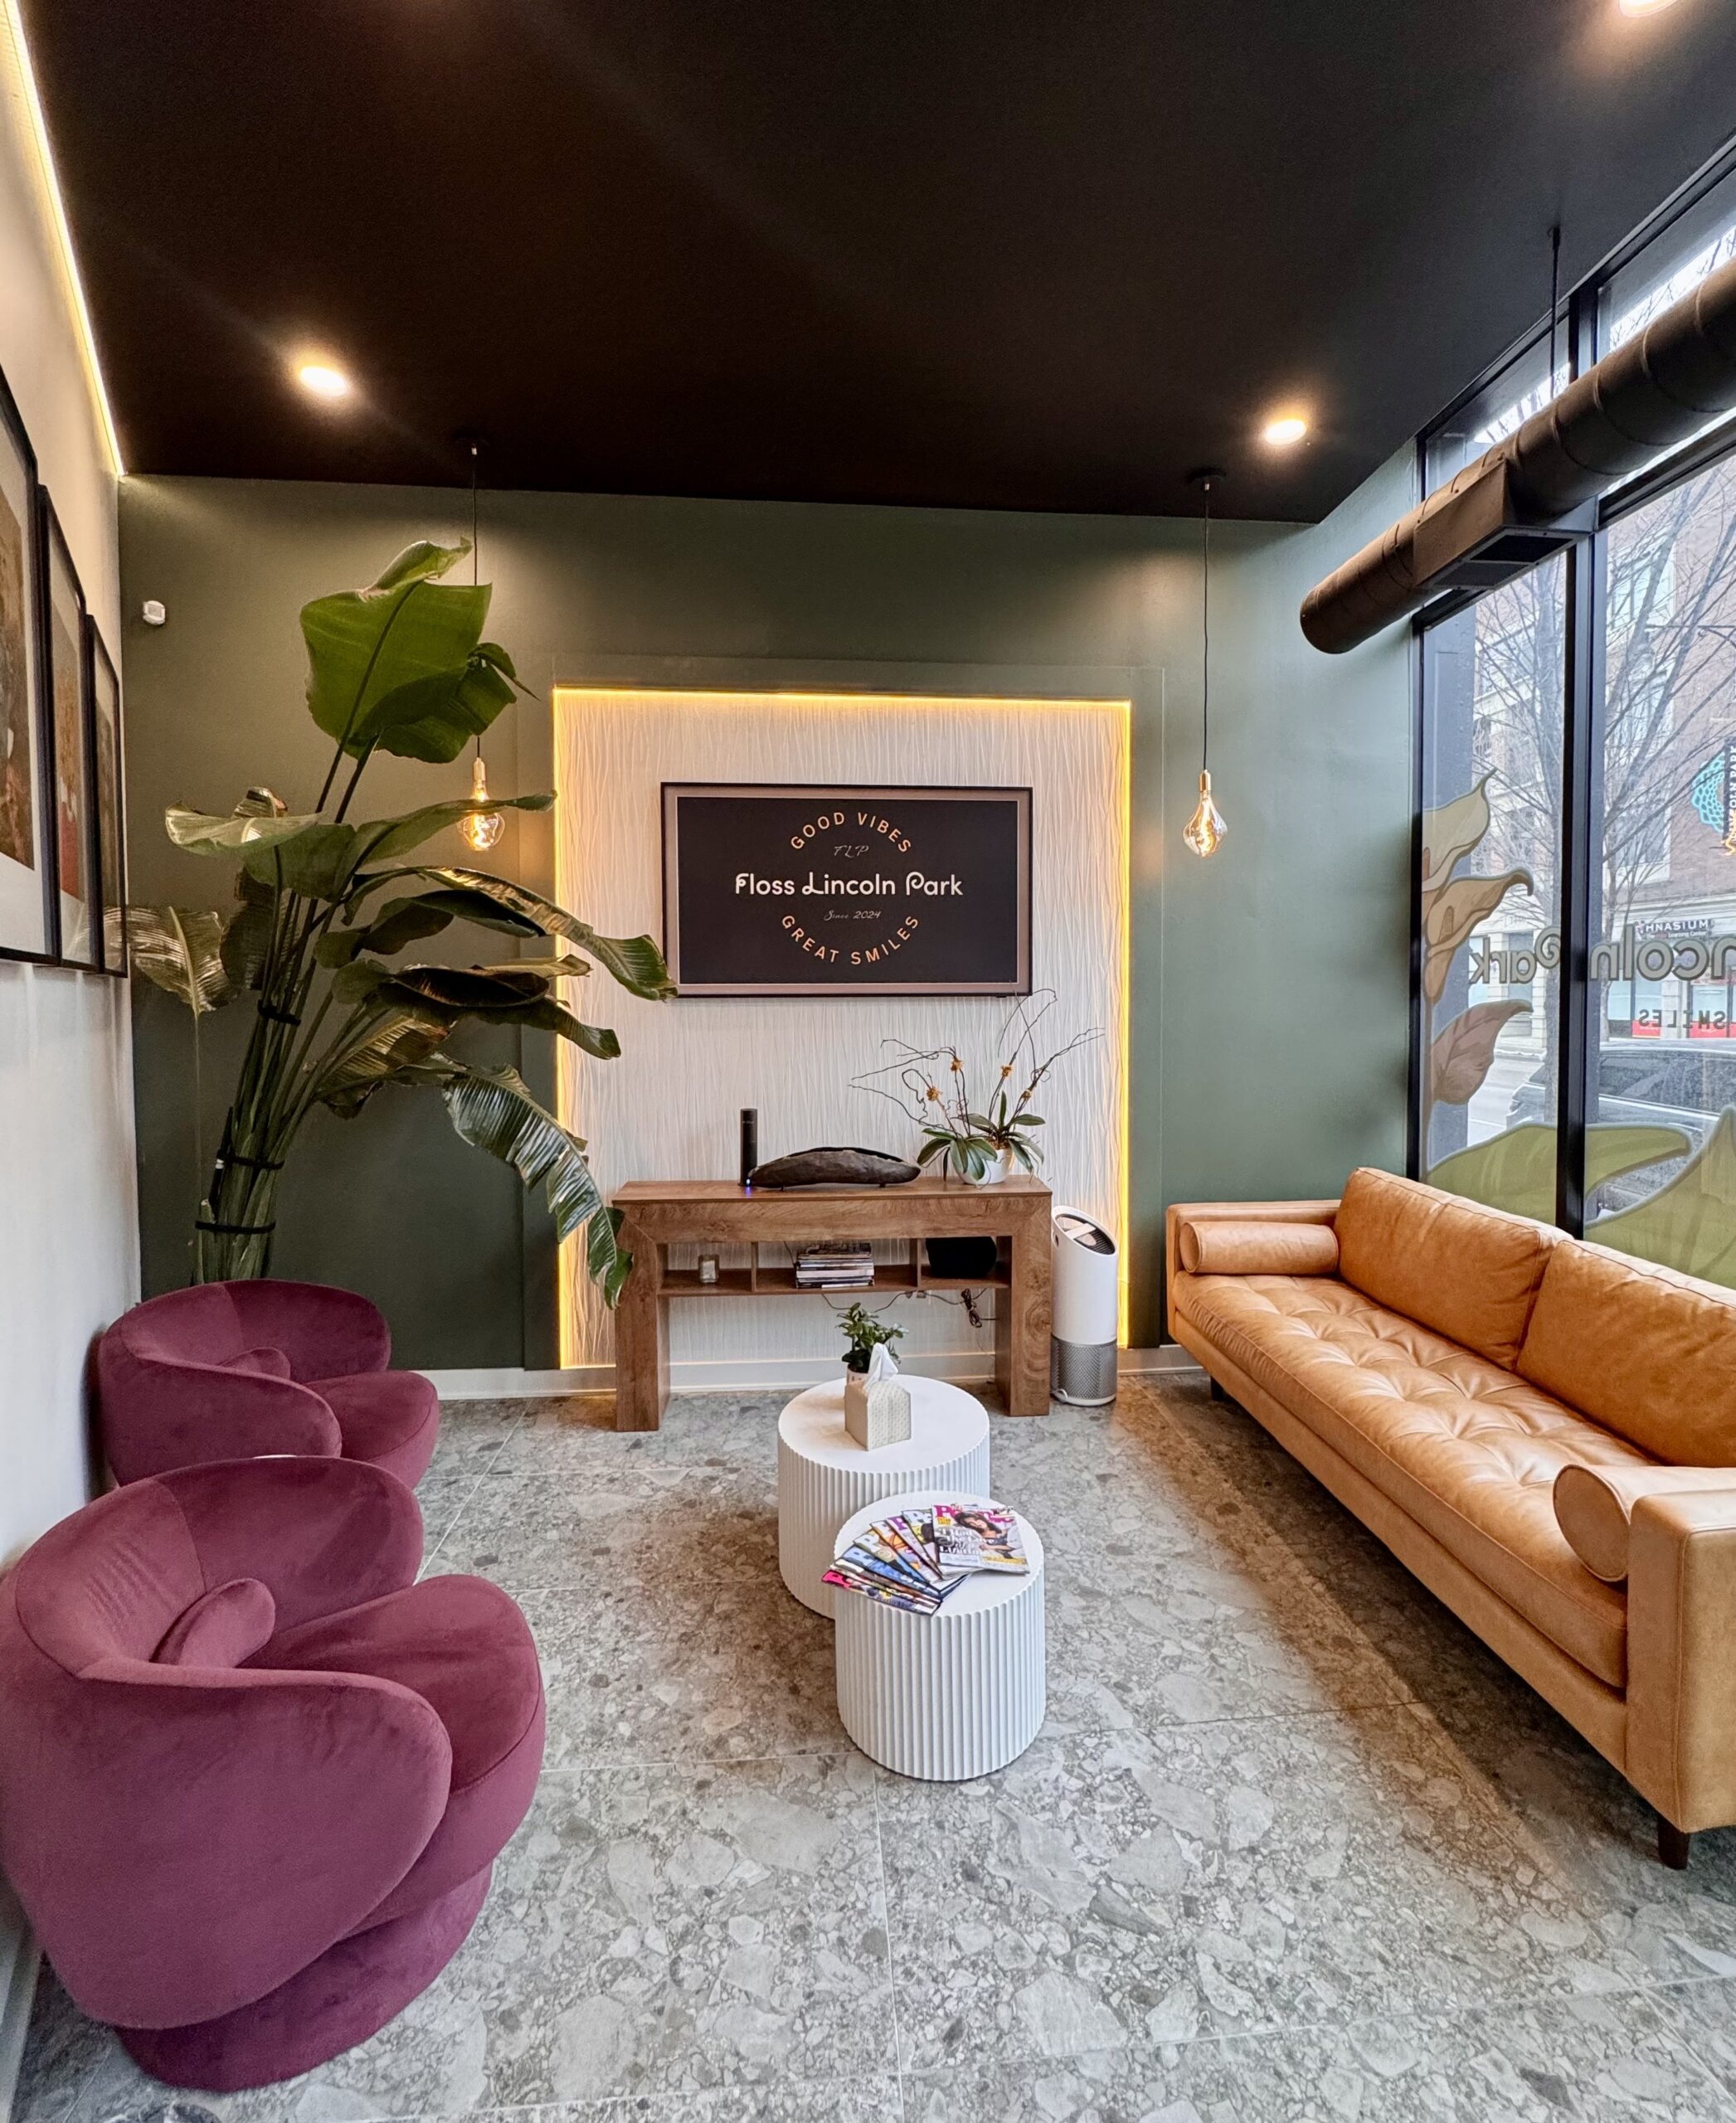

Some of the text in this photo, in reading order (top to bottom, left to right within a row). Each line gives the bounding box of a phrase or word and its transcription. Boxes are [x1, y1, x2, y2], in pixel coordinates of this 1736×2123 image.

[790, 812, 912, 853] GOOD VIBES
[834, 845, 869, 858] FLP
[735, 871, 964, 896] Floss Lincoln Park
[824, 909, 882, 921] Since 2024
[781, 915, 919, 965] GREAT SMILES
